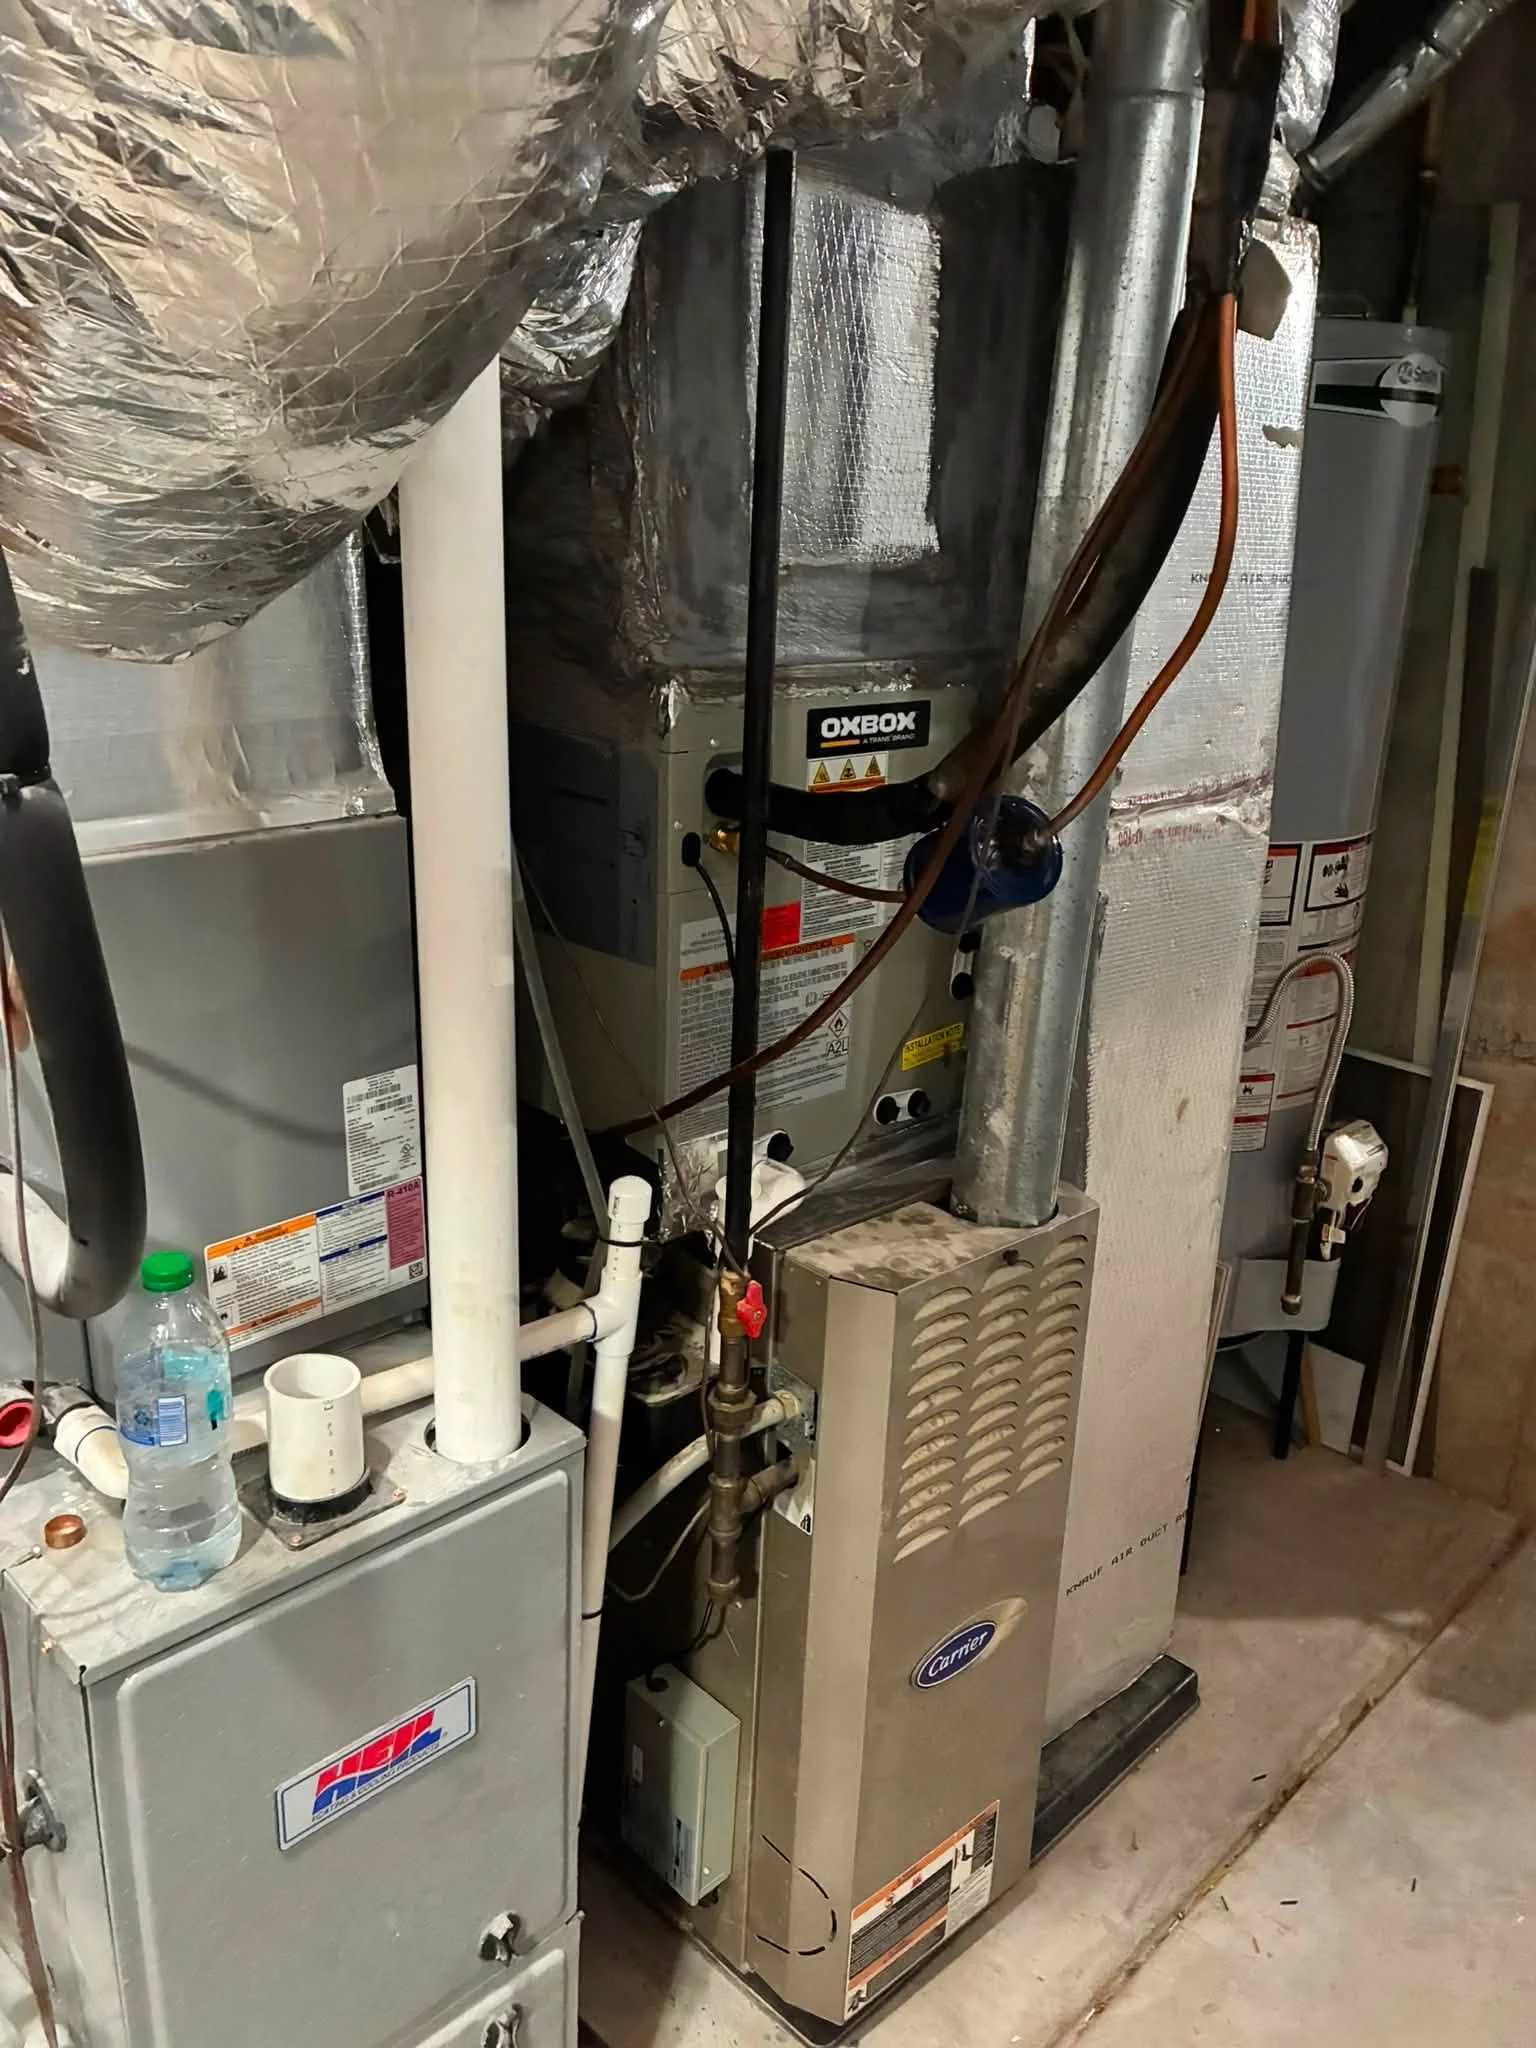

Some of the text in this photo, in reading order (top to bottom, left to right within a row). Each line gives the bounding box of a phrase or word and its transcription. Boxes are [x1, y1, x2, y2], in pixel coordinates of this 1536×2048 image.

[820, 710, 917, 739] OXBOX
[869, 735, 890, 744] TRANE
[827, 1039, 848, 1056] A2L
[904, 1031, 944, 1052] INSTALLATION
[387, 1181, 420, 1199] R-410A
[1066, 1523, 1168, 1596] KNAUF AIR DUCT
[928, 1631, 988, 1677] Carrier
[312, 1709, 442, 1816] HEIL
